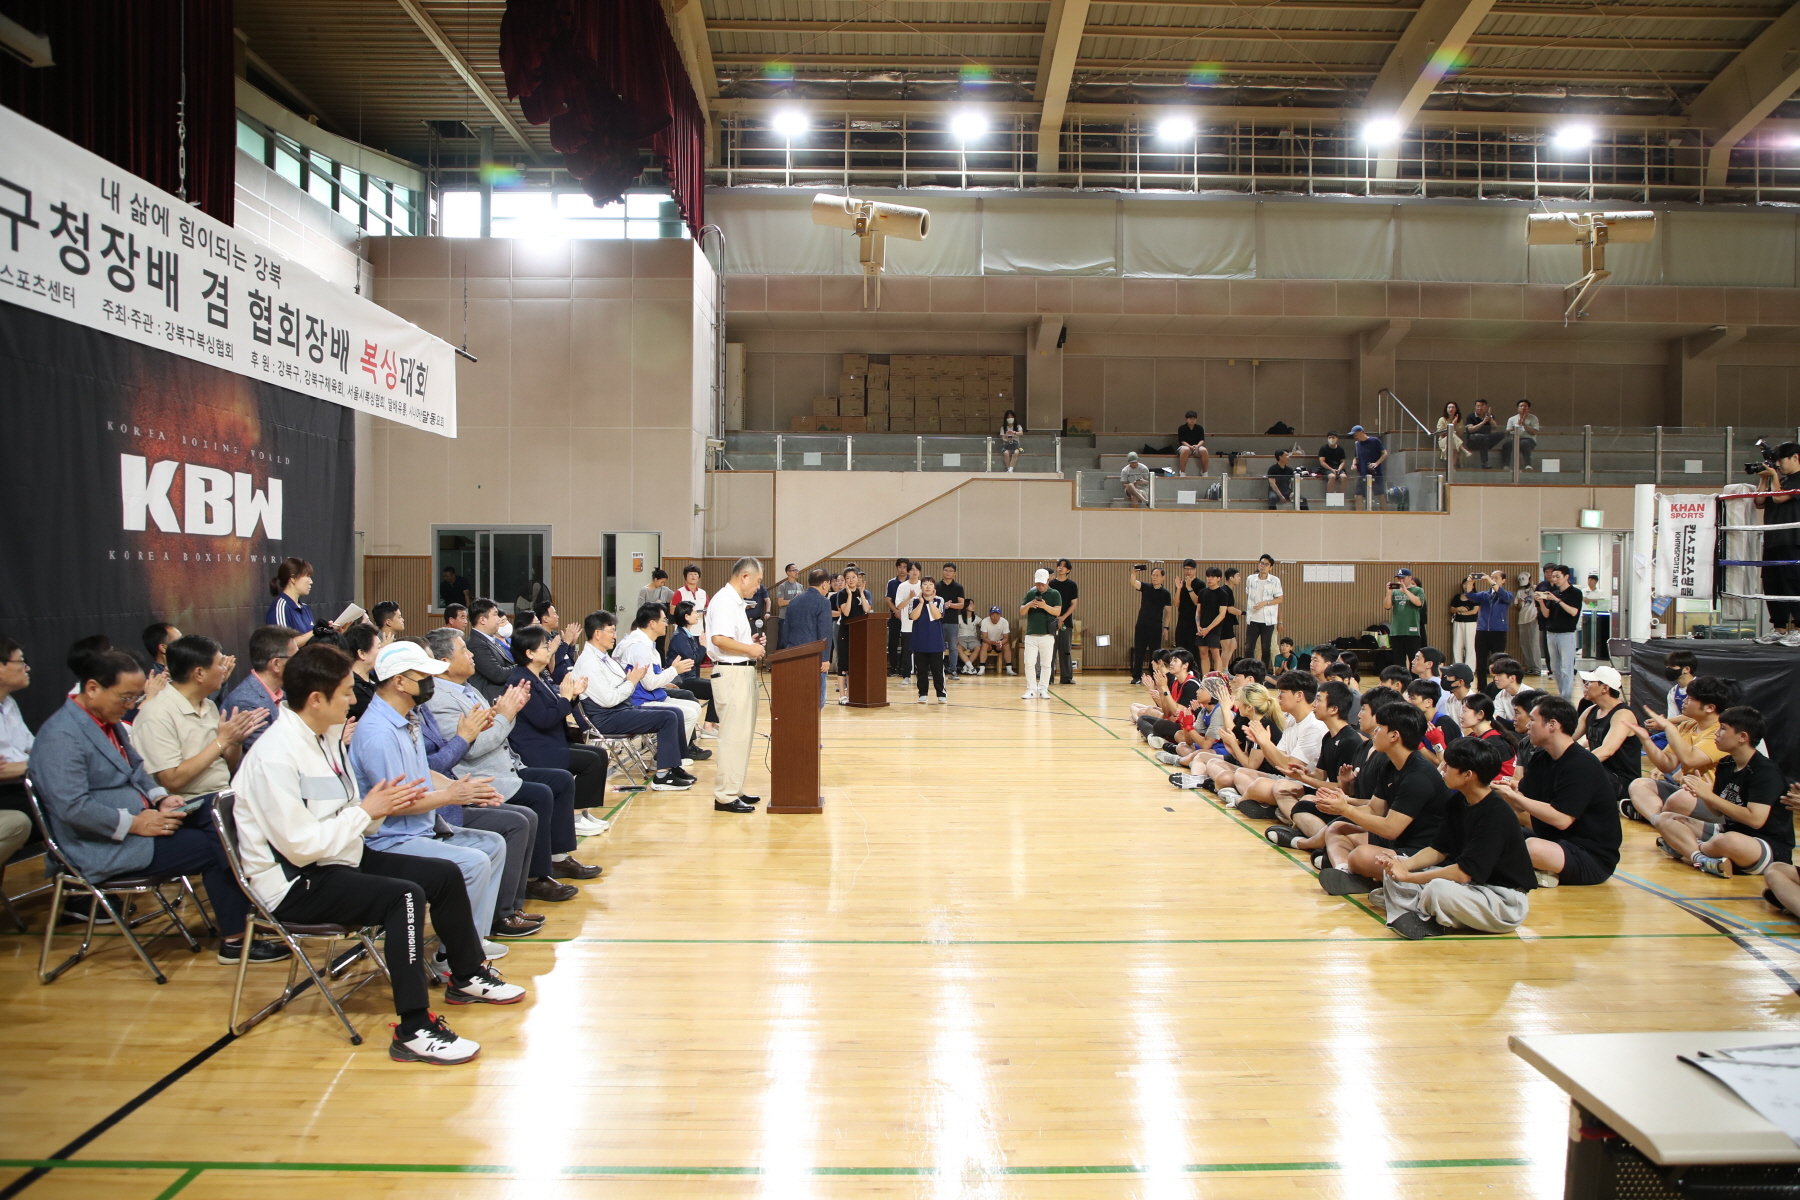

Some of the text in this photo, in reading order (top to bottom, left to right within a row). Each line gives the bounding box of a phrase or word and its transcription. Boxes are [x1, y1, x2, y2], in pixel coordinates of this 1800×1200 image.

[101, 177, 282, 290] 내 삶에 힘이되는 강북
[0, 264, 75, 309] 스포츠센터
[164, 320, 234, 361] 강북구복싱협회
[201, 268, 229, 330] 겸
[247, 289, 350, 375] 협회장배
[107, 420, 166, 441] KOREA
[182, 435, 239, 454] BOXING
[120, 452, 283, 541] KBW
[1670, 503, 1706, 513] KHAN
[109, 550, 170, 562] KOREA
[183, 552, 241, 563] BOXING
[404, 892, 417, 965] PARDES ORIGINAL
